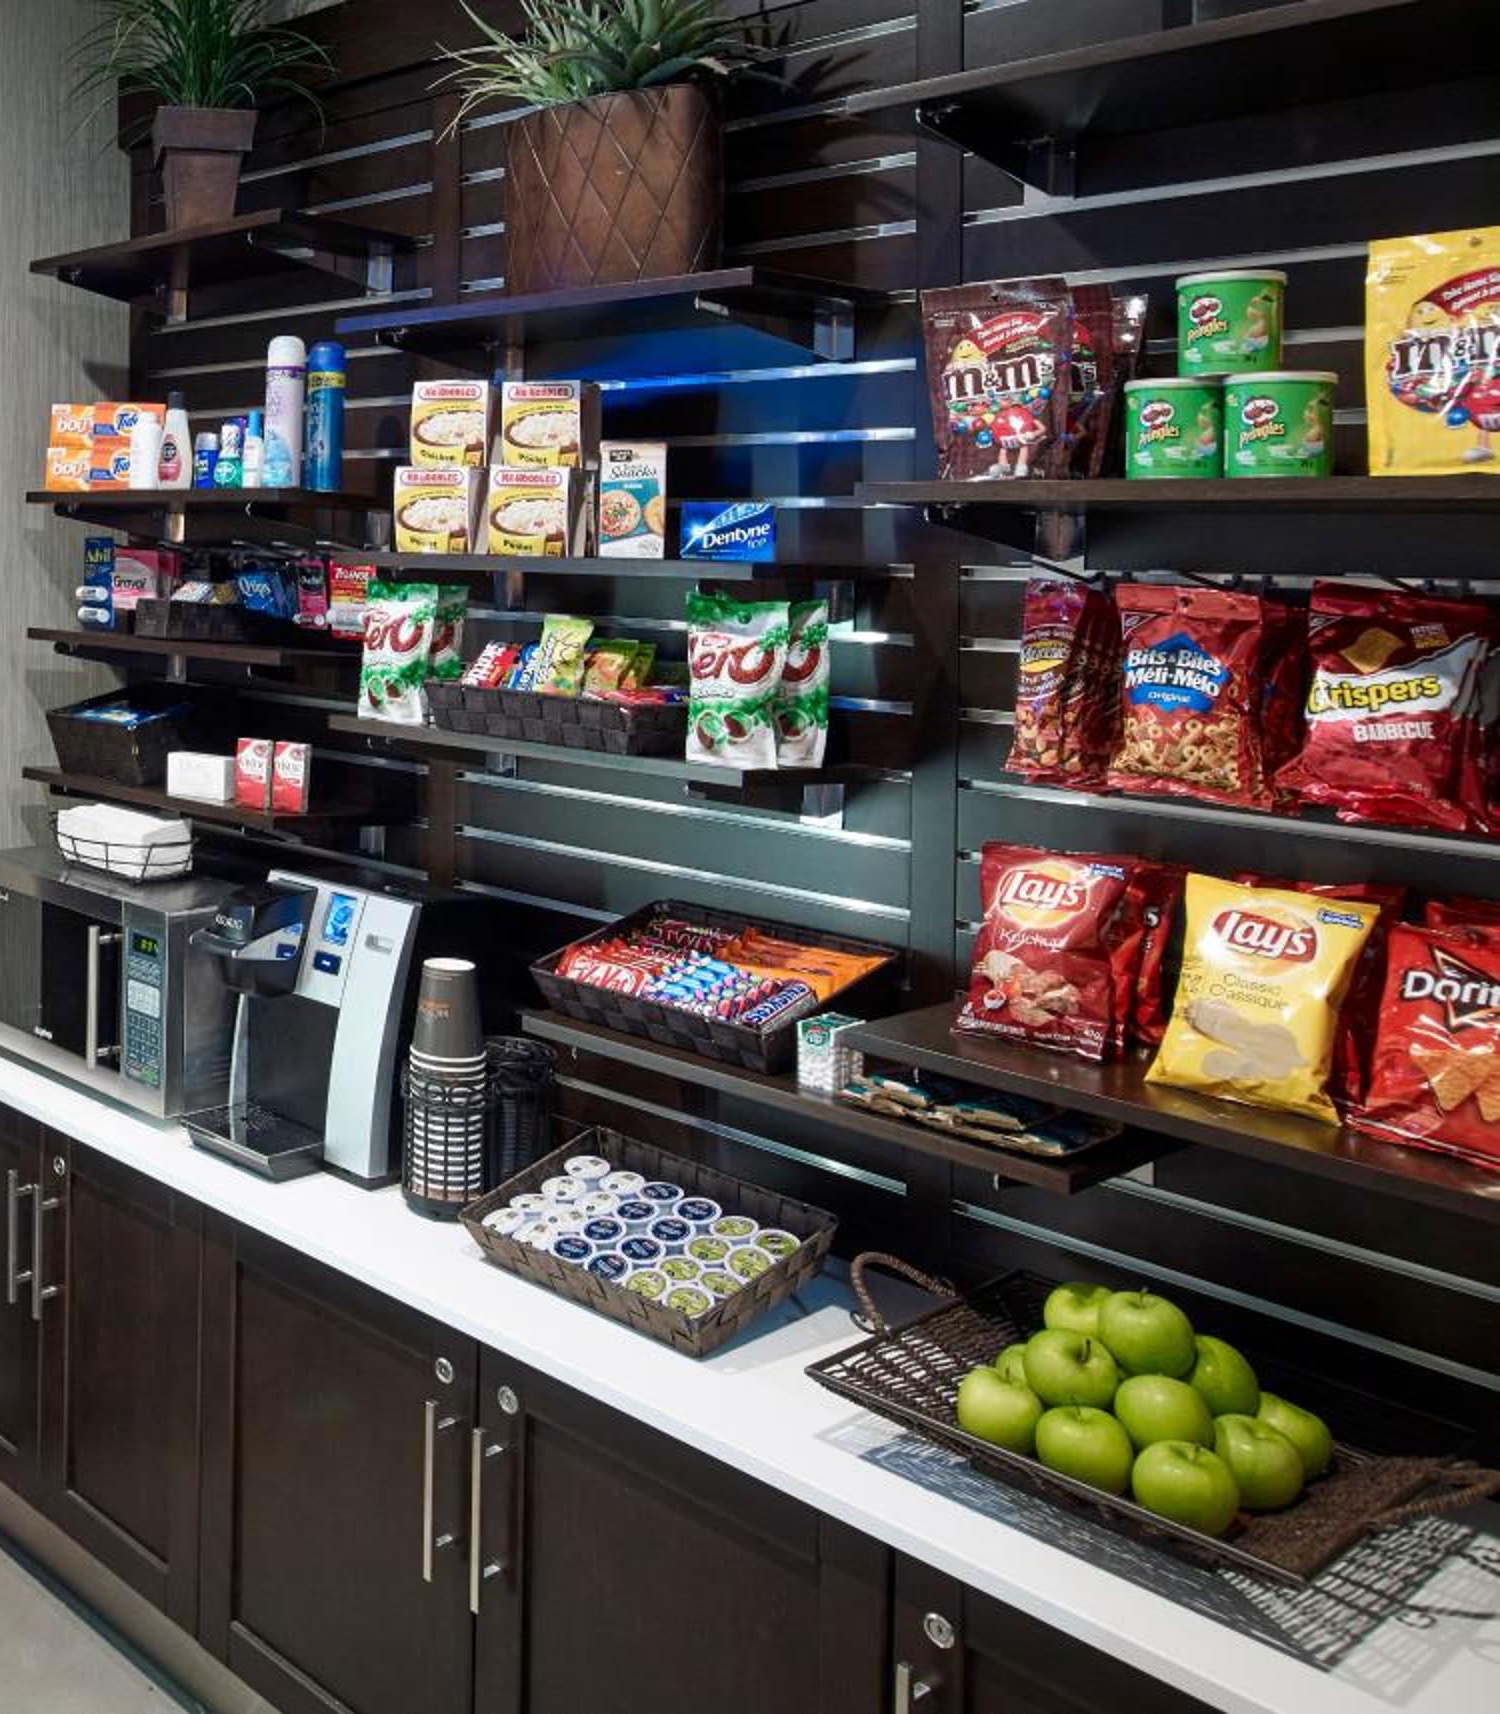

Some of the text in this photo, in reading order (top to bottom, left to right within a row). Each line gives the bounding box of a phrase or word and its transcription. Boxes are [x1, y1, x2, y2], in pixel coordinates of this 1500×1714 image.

[1187, 319, 1228, 341] Pringles
[1139, 426, 1179, 445] Pringles
[1240, 423, 1285, 443] Pringles
[703, 522, 770, 549] Dentyne
[1128, 649, 1167, 667] Bits
[1177, 649, 1221, 676] Bites
[1308, 674, 1441, 714] Crispers
[1354, 720, 1436, 743] BARBECUE
[1210, 984, 1290, 1011] Classique
[1224, 973, 1282, 997] Classic
[1404, 970, 1500, 1007] Dorit
